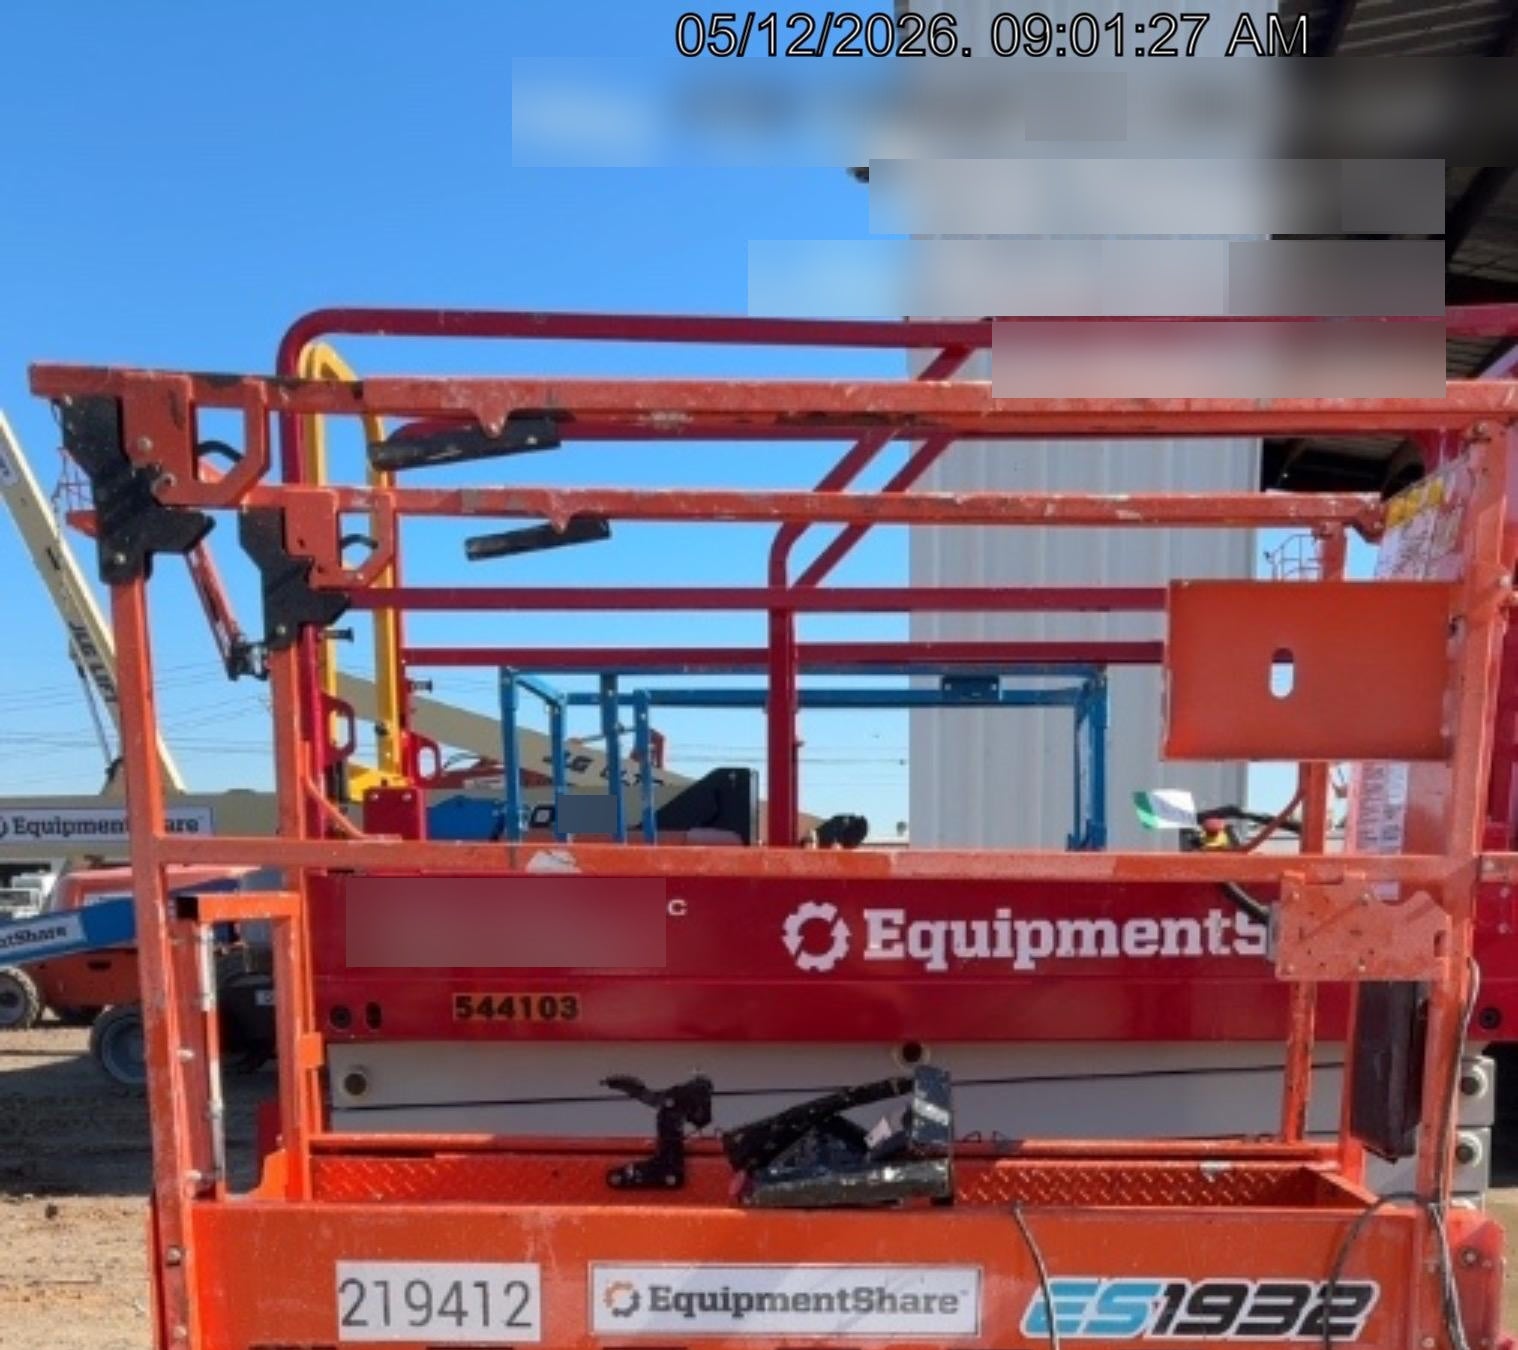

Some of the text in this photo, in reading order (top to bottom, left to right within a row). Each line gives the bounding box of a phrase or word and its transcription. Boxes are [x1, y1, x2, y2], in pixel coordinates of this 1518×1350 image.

[455, 995, 579, 1019] 544103
[338, 1279, 532, 1328] 219412
[648, 1284, 959, 1322] EquipmentShare
[1021, 1278, 1379, 1341] ES1932
